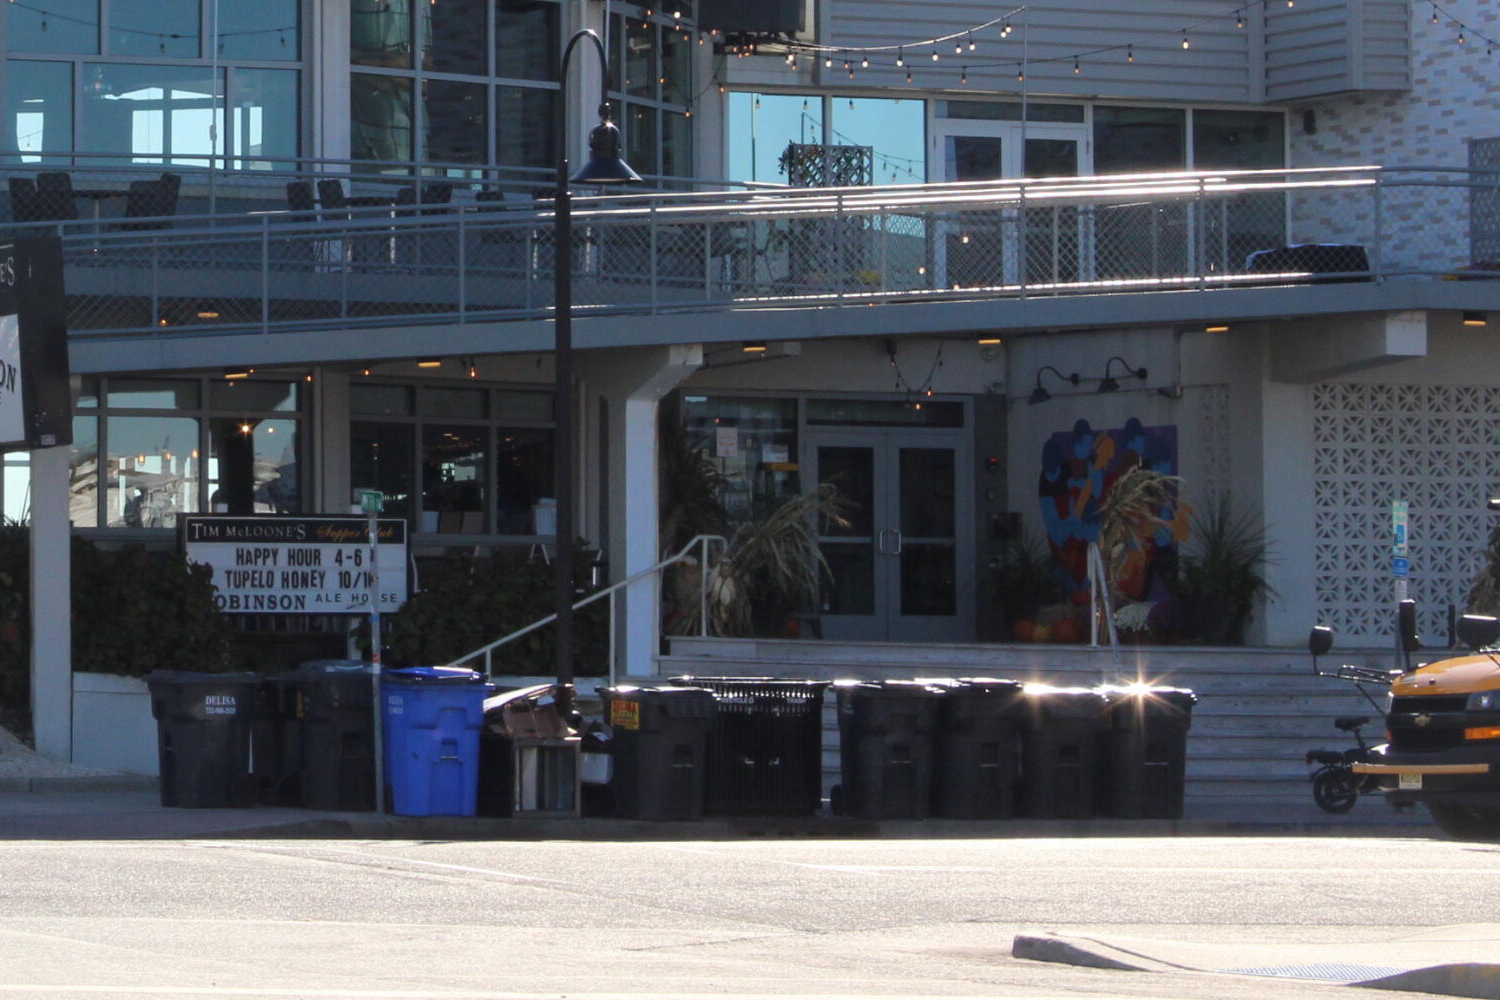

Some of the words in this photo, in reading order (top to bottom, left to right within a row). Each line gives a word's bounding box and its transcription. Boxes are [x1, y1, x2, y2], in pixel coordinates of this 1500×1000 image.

[236, 548, 278, 567] HAPPY
[288, 548, 322, 567] HOUR
[334, 548, 363, 567] 4-6
[225, 571, 274, 589] TUPELO
[281, 569, 326, 589] HONEY
[214, 594, 306, 610] OBINSON
[315, 593, 342, 603] ALE
[351, 593, 397, 603] HOSE
[205, 695, 236, 705] DELISA
